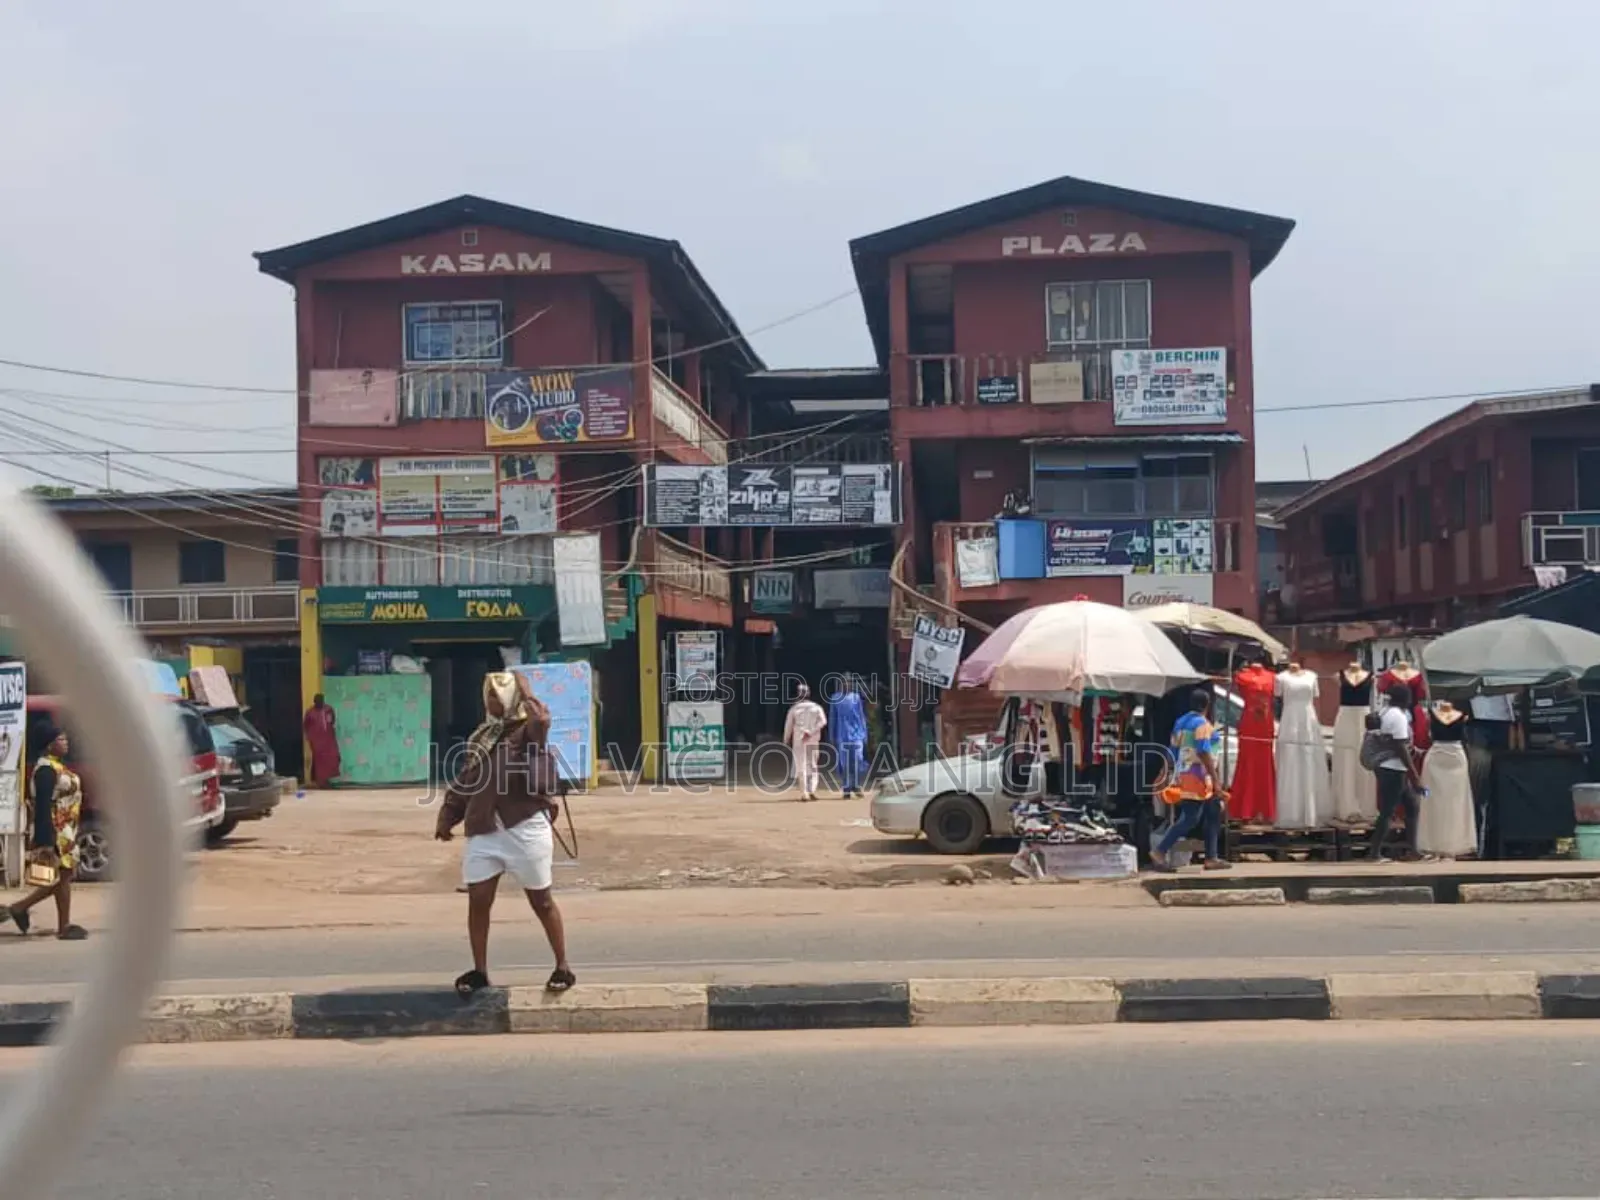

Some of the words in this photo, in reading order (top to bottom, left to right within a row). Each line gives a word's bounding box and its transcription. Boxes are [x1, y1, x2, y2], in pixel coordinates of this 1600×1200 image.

[1002, 232, 1147, 256] PLAZA
[401, 252, 552, 274] KASAM
[530, 371, 574, 392] WOW
[530, 389, 576, 407] STUDIO
[757, 579, 790, 597] NIN
[371, 602, 428, 620] MOUKA
[466, 601, 523, 617] FOAM
[918, 619, 960, 643] NYSC
[0, 673, 22, 704] YSC
[672, 728, 720, 747] NYSC
